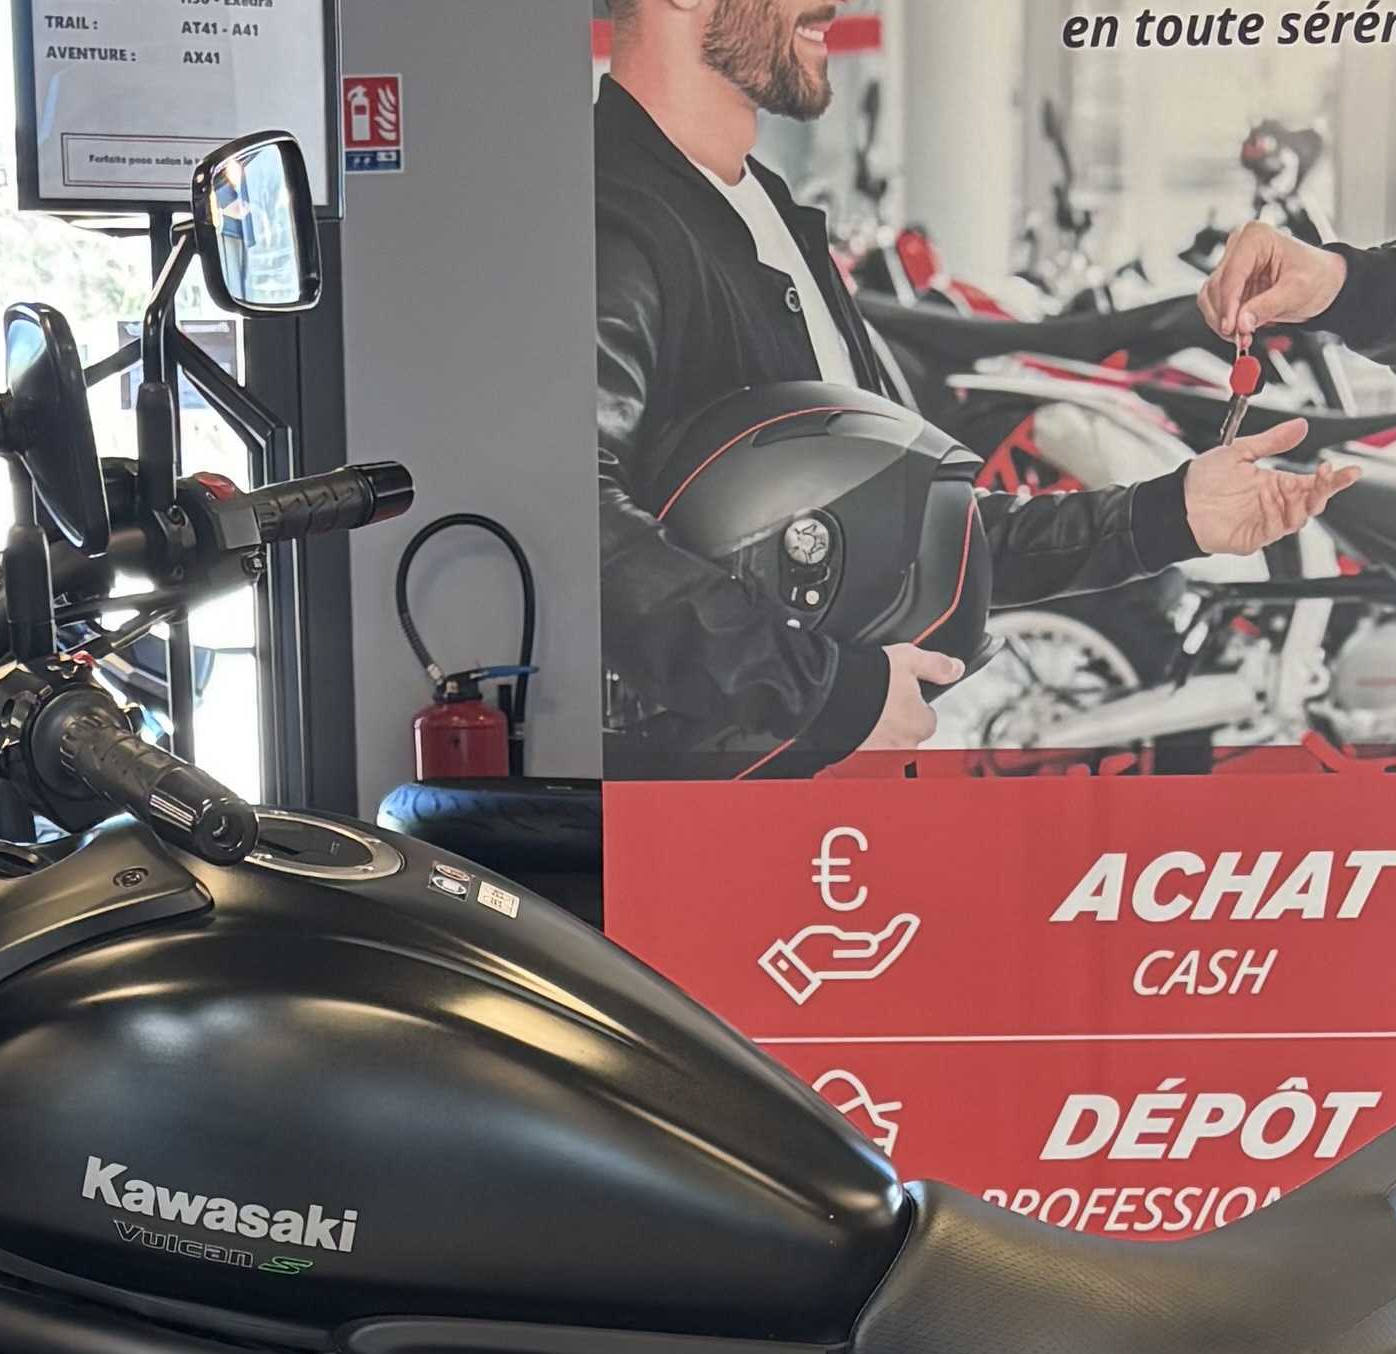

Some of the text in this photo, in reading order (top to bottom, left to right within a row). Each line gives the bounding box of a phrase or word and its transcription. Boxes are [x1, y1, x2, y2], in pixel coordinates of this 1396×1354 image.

[45, 15, 89, 30] TRAIL
[181, 21, 218, 35] AT41
[232, 23, 259, 36] A41
[1062, 15, 1119, 48] en
[1135, 8, 1265, 47] toute
[46, 46, 128, 62] AVENTURE
[183, 51, 221, 64] AX41
[1132, 948, 1278, 997] CASH
[1039, 1074, 1383, 1161] DÉPÔT
[81, 1155, 358, 1253] Kawasaki
[112, 1219, 254, 1268] Vulcan
